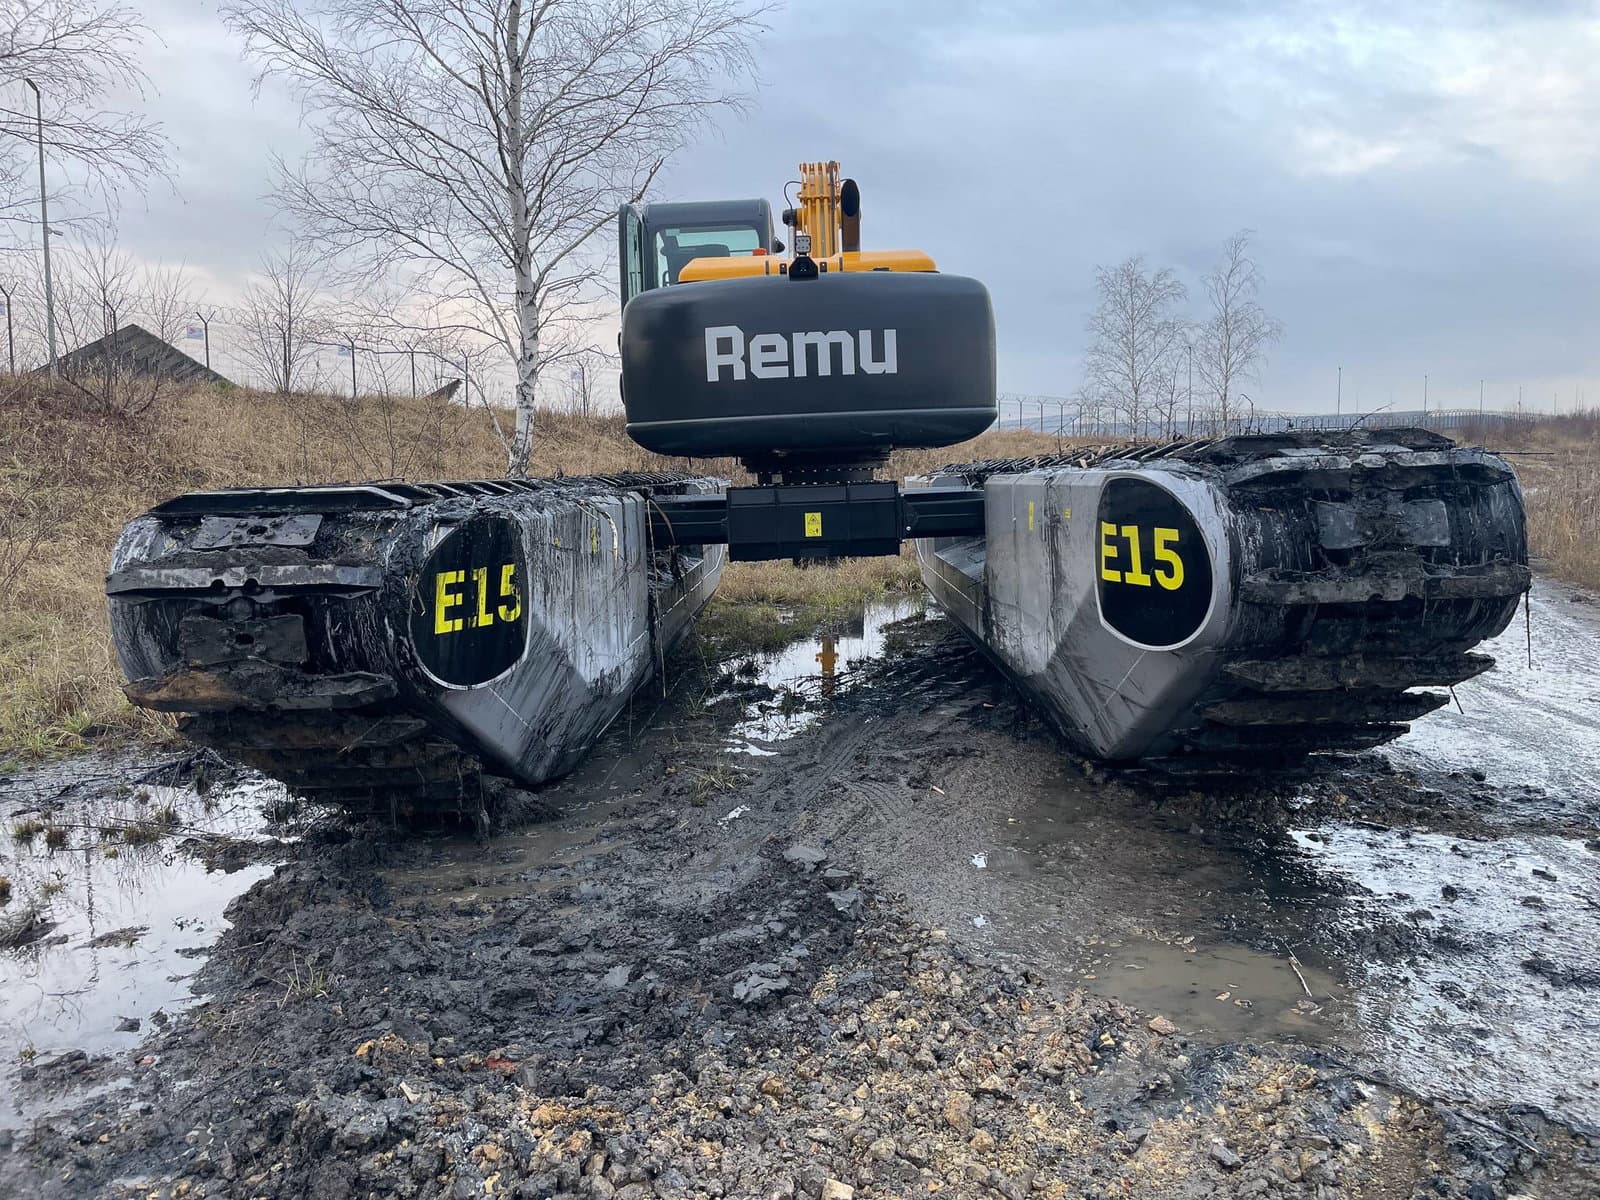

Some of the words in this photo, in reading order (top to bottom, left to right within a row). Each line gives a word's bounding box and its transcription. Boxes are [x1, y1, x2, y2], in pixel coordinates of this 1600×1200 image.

[705, 325, 898, 382] Remu
[1101, 521, 1185, 591] E15
[434, 564, 521, 635] E15
